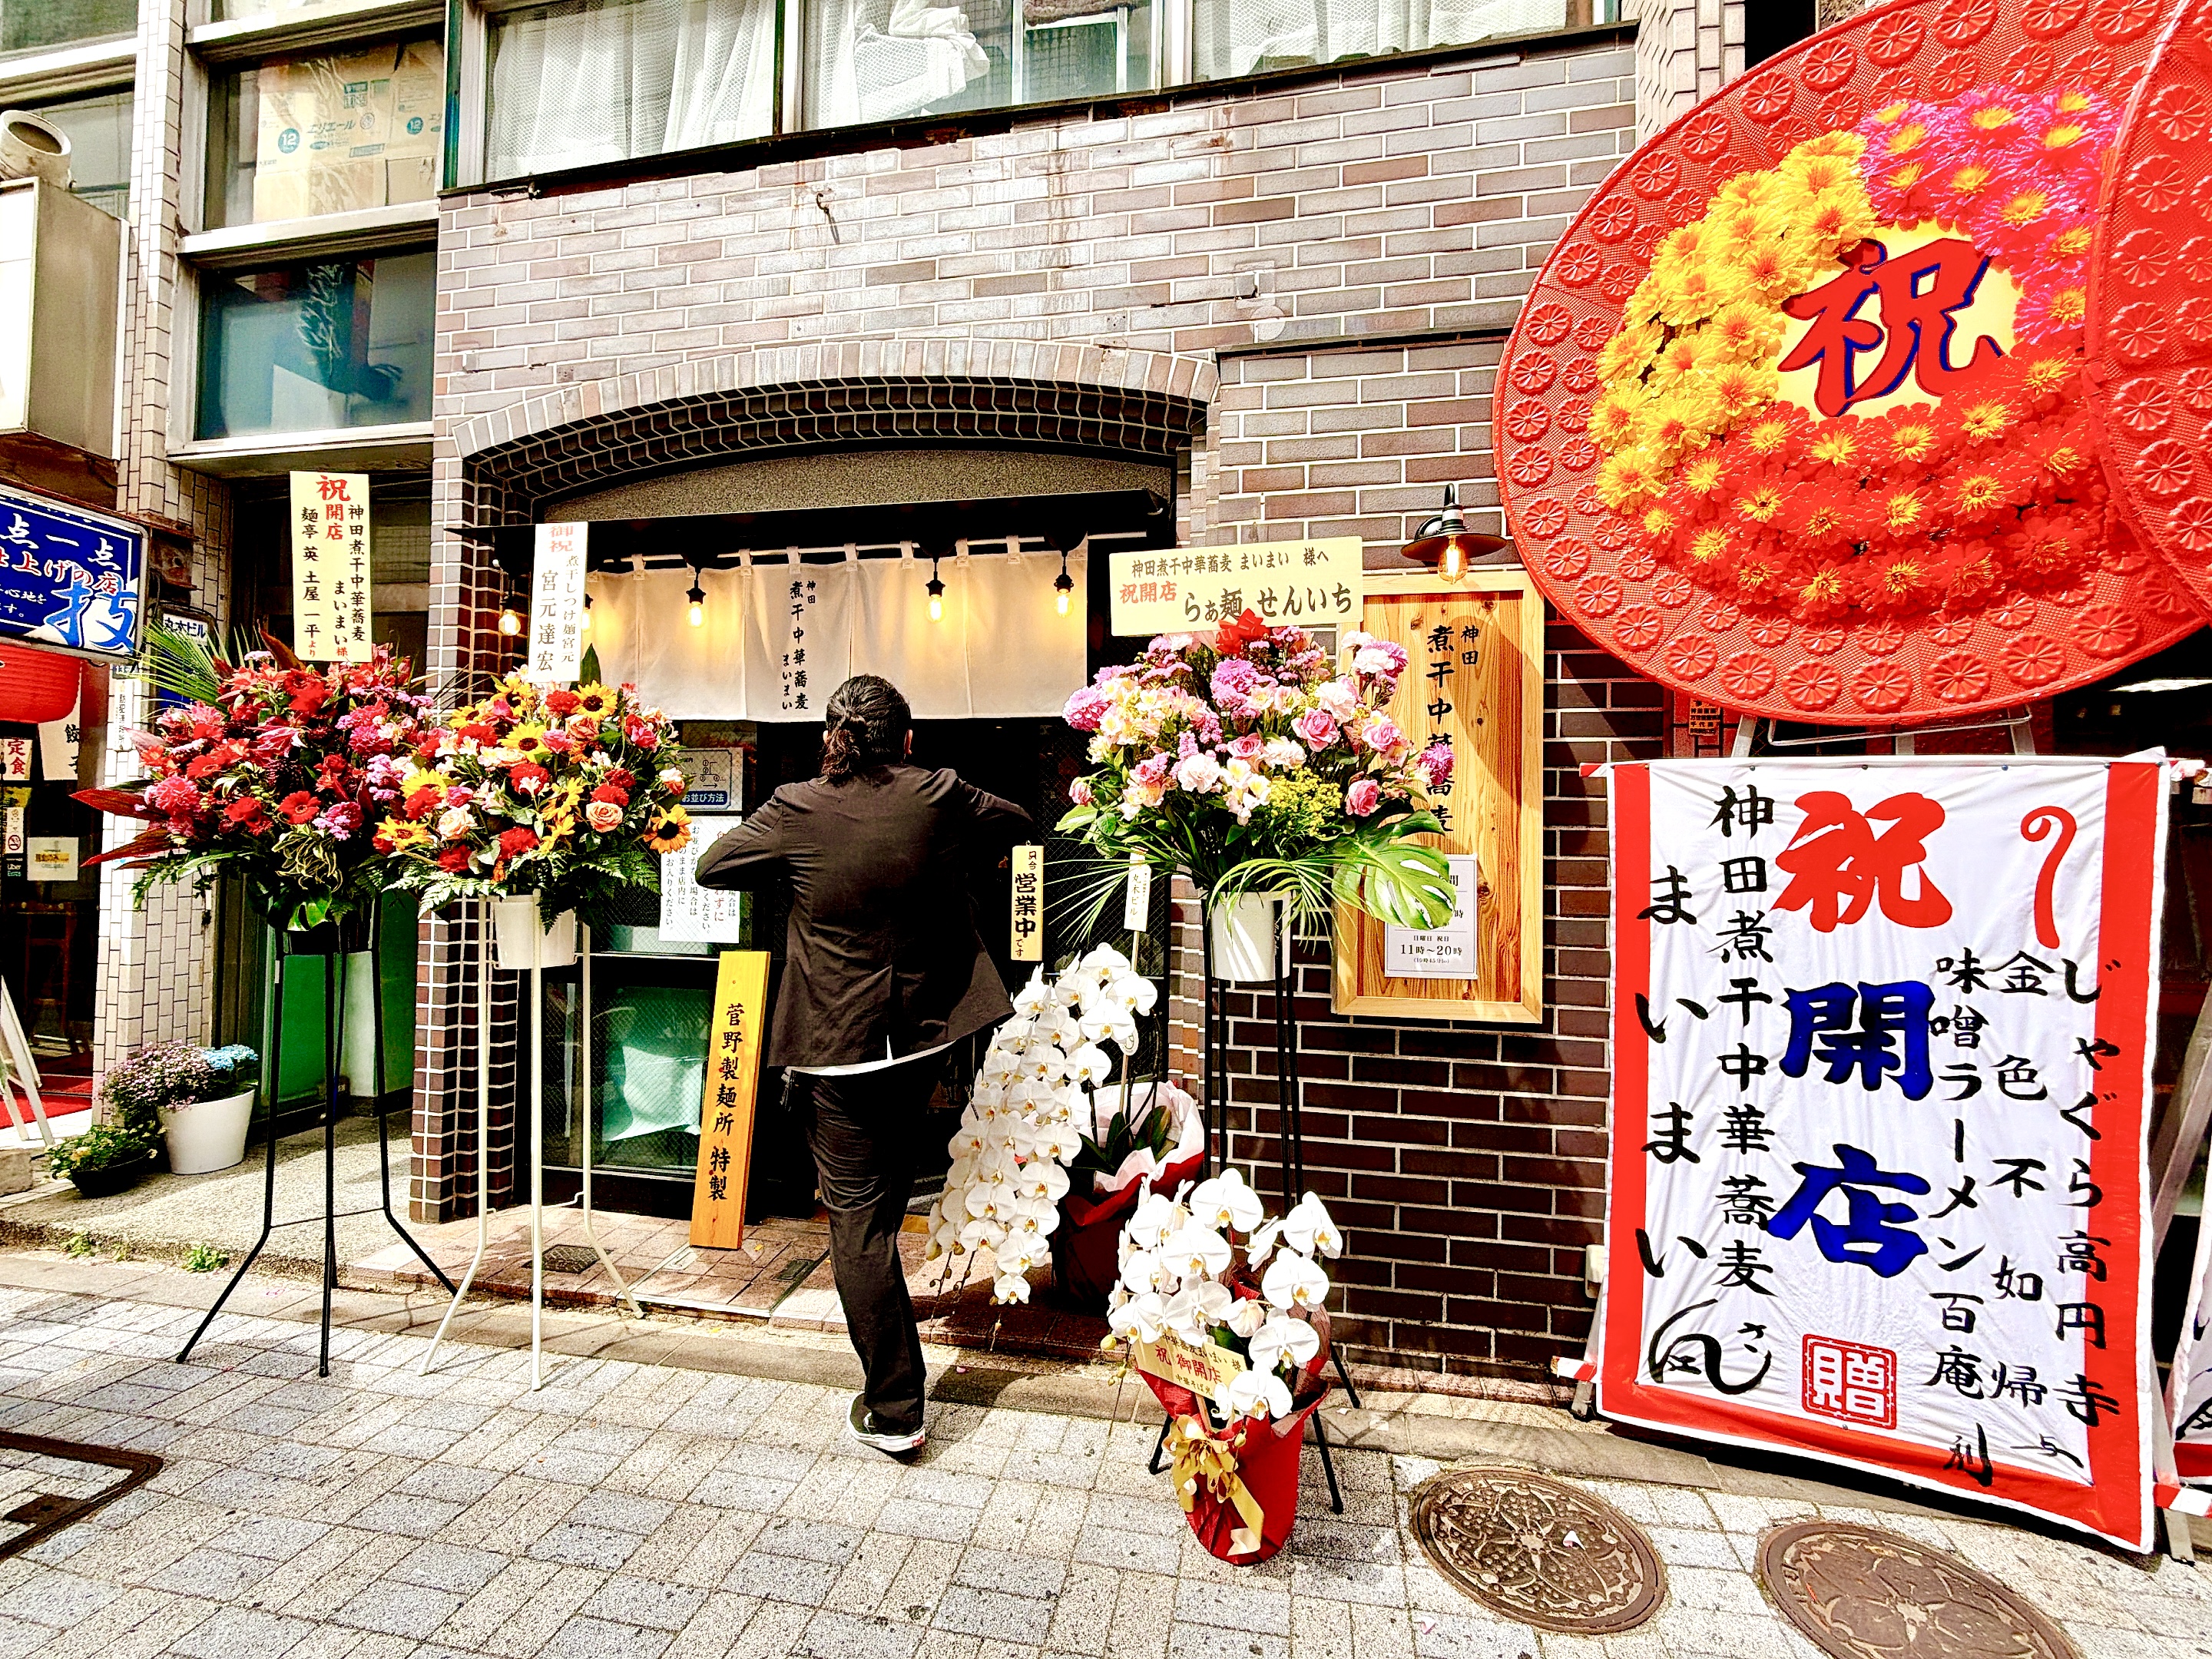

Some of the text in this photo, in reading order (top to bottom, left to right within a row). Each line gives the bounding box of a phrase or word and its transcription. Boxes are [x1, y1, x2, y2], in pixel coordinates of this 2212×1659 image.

[282, 134, 296, 146] 12
[307, 121, 356, 134] エリエール
[1777, 237, 2003, 417] 祝
[348, 504, 366, 641] 神田煮干中華蕎麦
[549, 525, 574, 552] 御祝
[1131, 547, 1329, 578] 神田煮干中華蕎麦 まいまい 様へ
[44, 563, 138, 655] 技
[536, 570, 558, 671] 宮元達宏
[561, 555, 579, 663] 煮干しつけ麺宮元
[806, 580, 816, 604] 神田
[1119, 580, 1177, 604] 祝開店
[1184, 581, 1352, 622] らぁ麺 せんいち
[790, 581, 808, 710] 煮干中華蕎麦
[1461, 624, 1479, 665] 神田
[782, 654, 792, 710] まいまい
[8, 738, 25, 775] 定食
[682, 793, 724, 803] お並び方法
[1770, 791, 1952, 932] 祝
[702, 885, 711, 934] ください。
[1015, 873, 1037, 938] 営業中
[1015, 939, 1024, 958] です
[1635, 865, 1708, 1277] まいまい
[1706, 784, 1777, 1296] 神田煮干中華蕎麦
[708, 1003, 744, 1201] 菅野製麺所 特製
[1767, 980, 1937, 1279] 開店
[1923, 947, 1991, 1399] 味噌ラーメン百庵
[1985, 950, 2055, 1408] 金色不如帰
[2053, 958, 2121, 1427] じゃぐら高円寺
[1155, 1344, 1223, 1384] 祝 御開店
[1813, 1344, 1886, 1421] 贈
